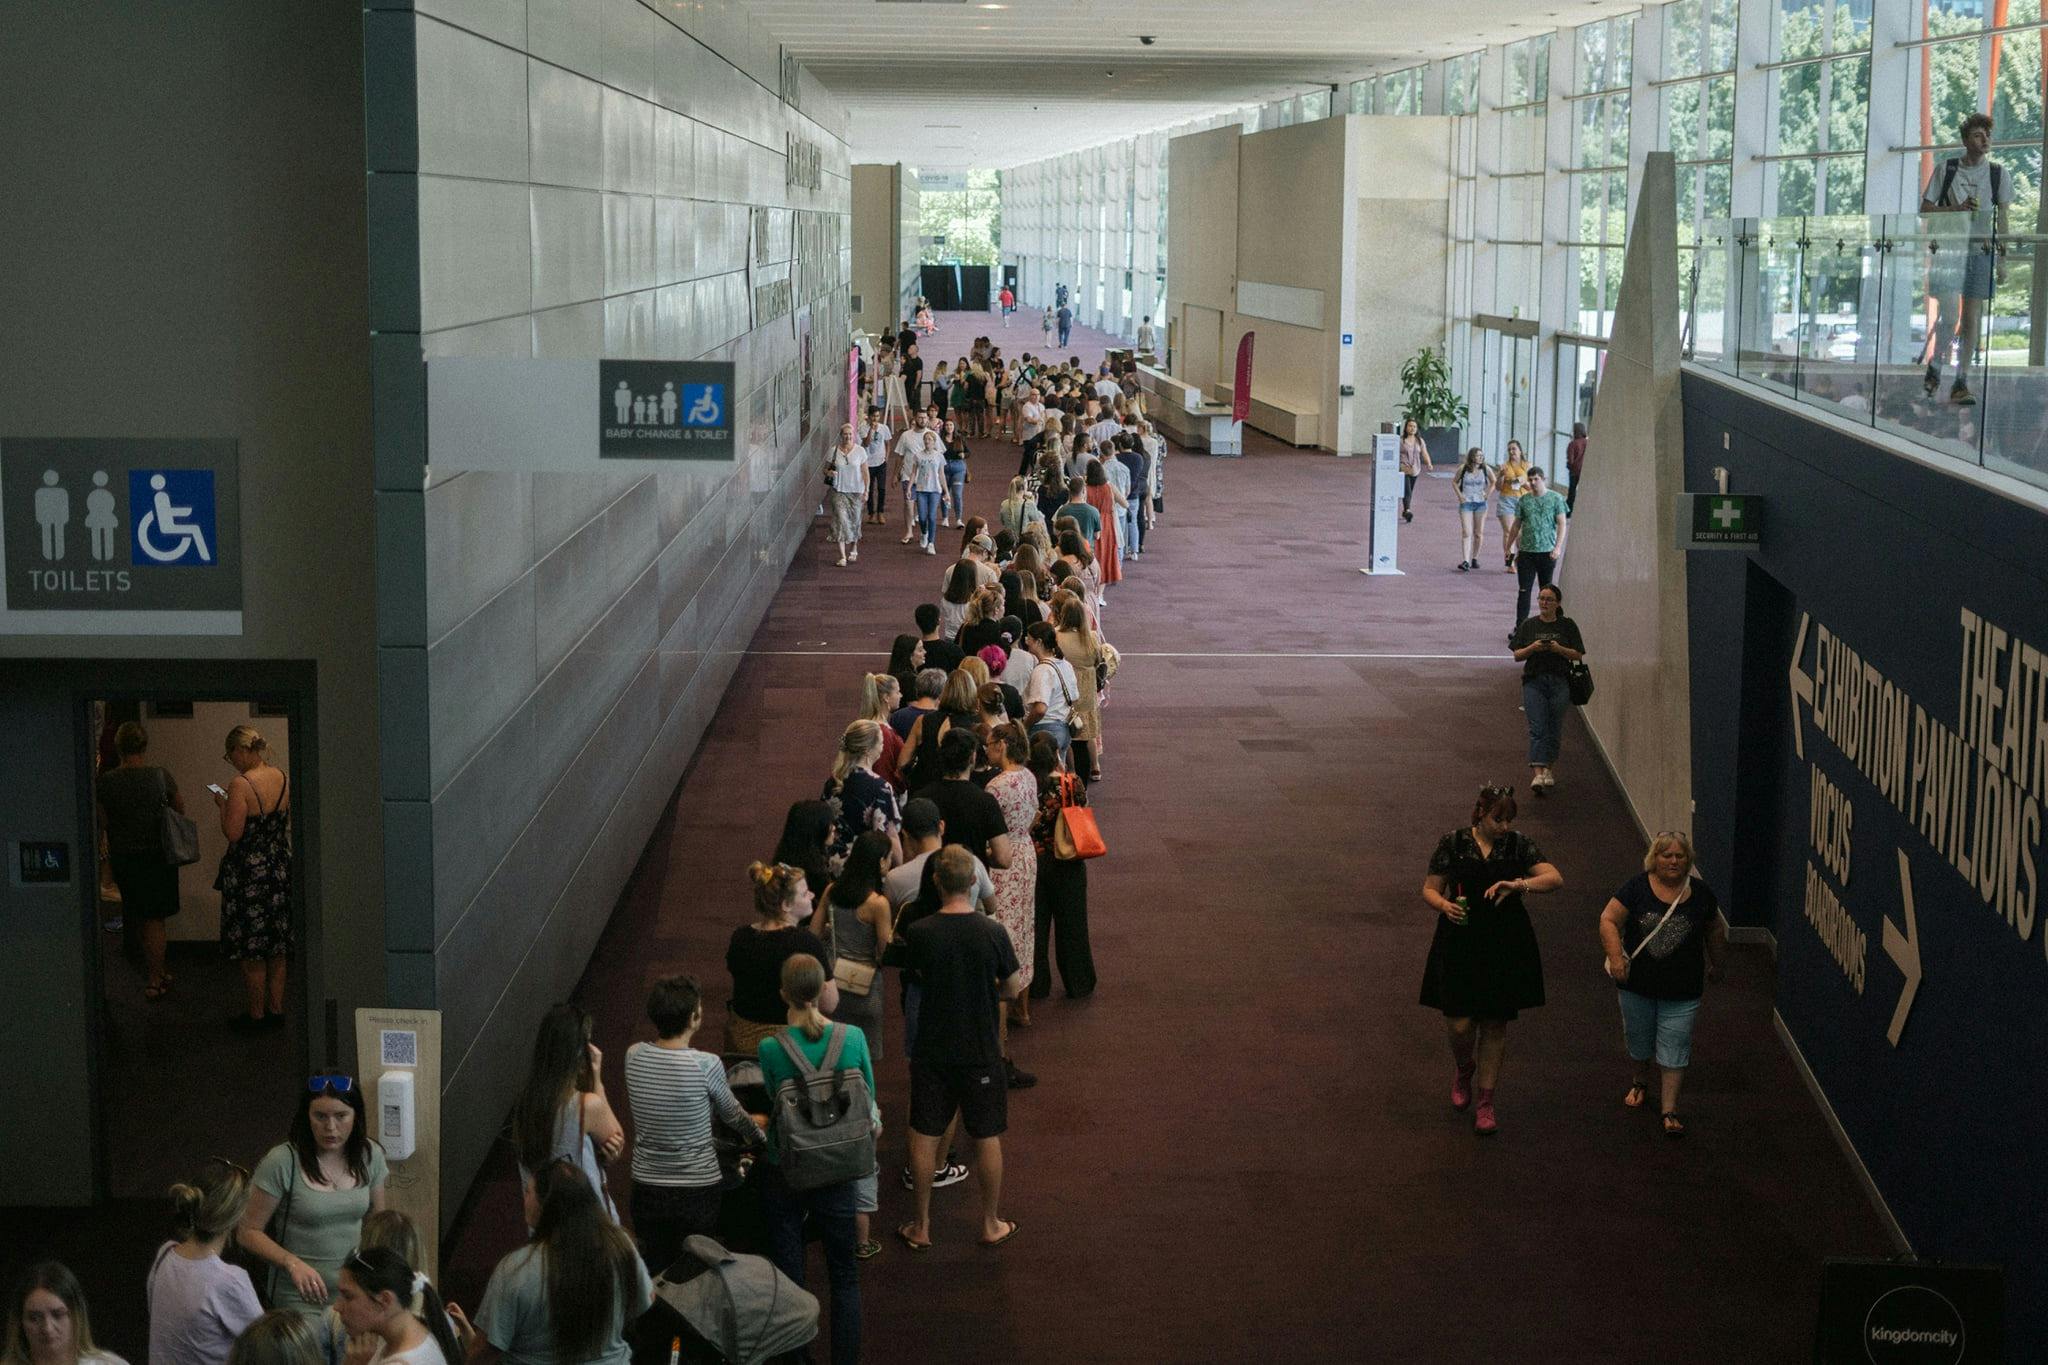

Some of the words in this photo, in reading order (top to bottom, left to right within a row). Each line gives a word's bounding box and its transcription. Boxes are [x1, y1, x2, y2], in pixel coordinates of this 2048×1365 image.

[605, 429, 634, 439] BABY
[636, 429, 682, 440] CHANGE
[684, 430, 692, 440] &
[694, 430, 729, 440] TOILET
[1695, 532, 1723, 540] SECURITY
[1730, 532, 1747, 541] FIRST
[1748, 533, 1759, 541] AID
[28, 570, 131, 591] TOILETS
[1813, 622, 1910, 813] EXHIBITION
[1909, 703, 2041, 941] PAVILIONS
[1810, 762, 1852, 886] VOCUS
[1804, 859, 1867, 996] BOARDROOMS
[1871, 1326, 1958, 1347] kingdomcity
